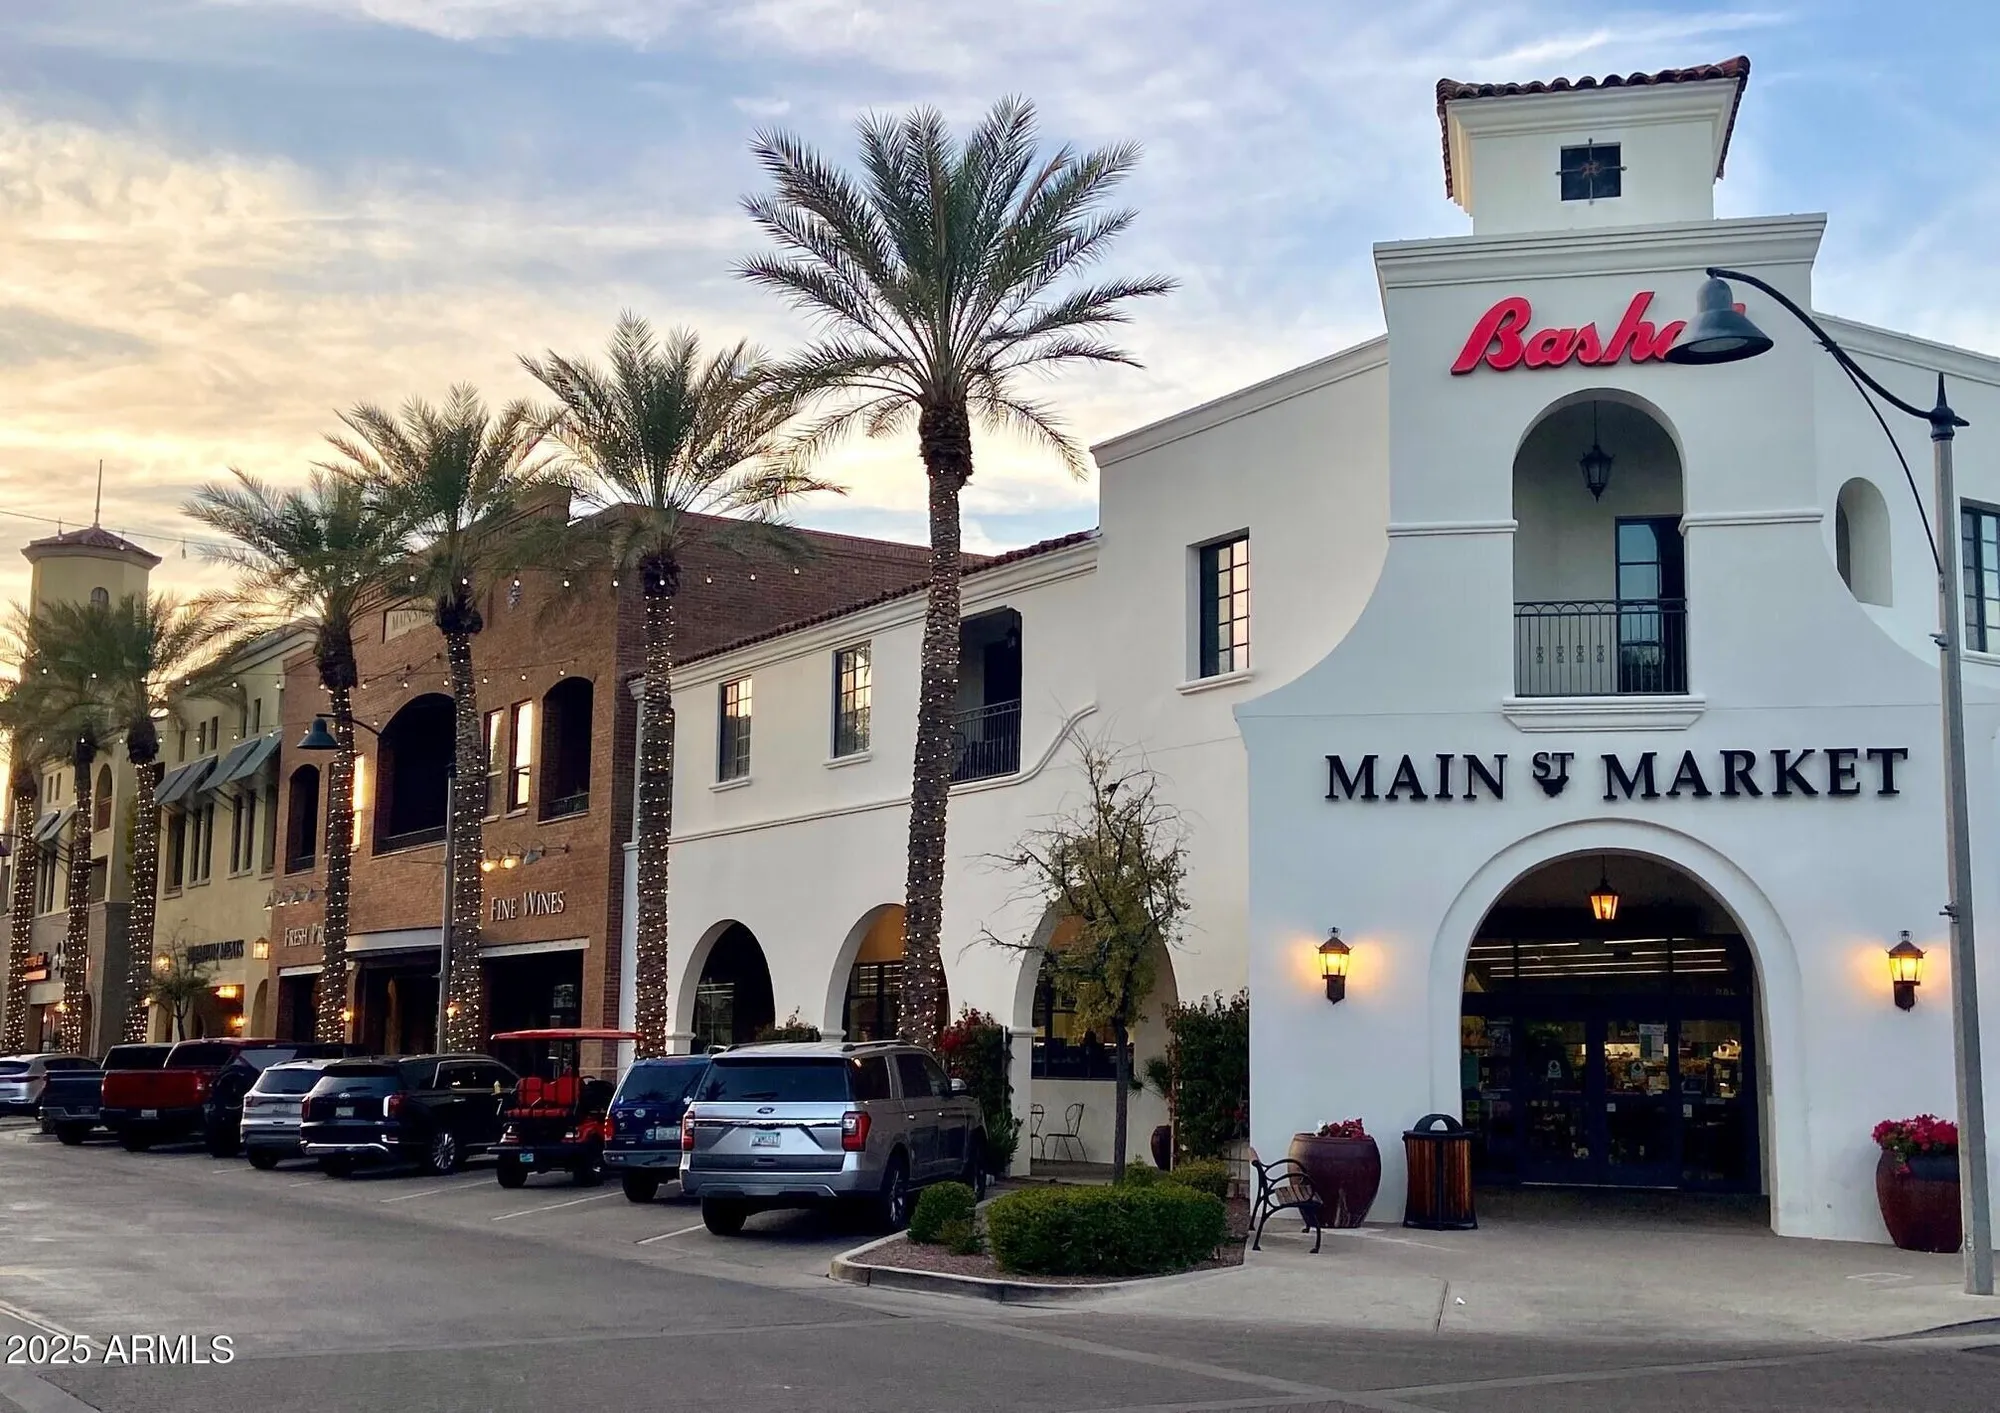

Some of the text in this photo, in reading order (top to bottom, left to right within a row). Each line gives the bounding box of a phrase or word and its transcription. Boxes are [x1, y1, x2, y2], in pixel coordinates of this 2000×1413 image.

[1324, 747, 1909, 801] MAIN ST MARKET
[490, 889, 566, 921] FINE WINES
[284, 927, 308, 947] FRESH
